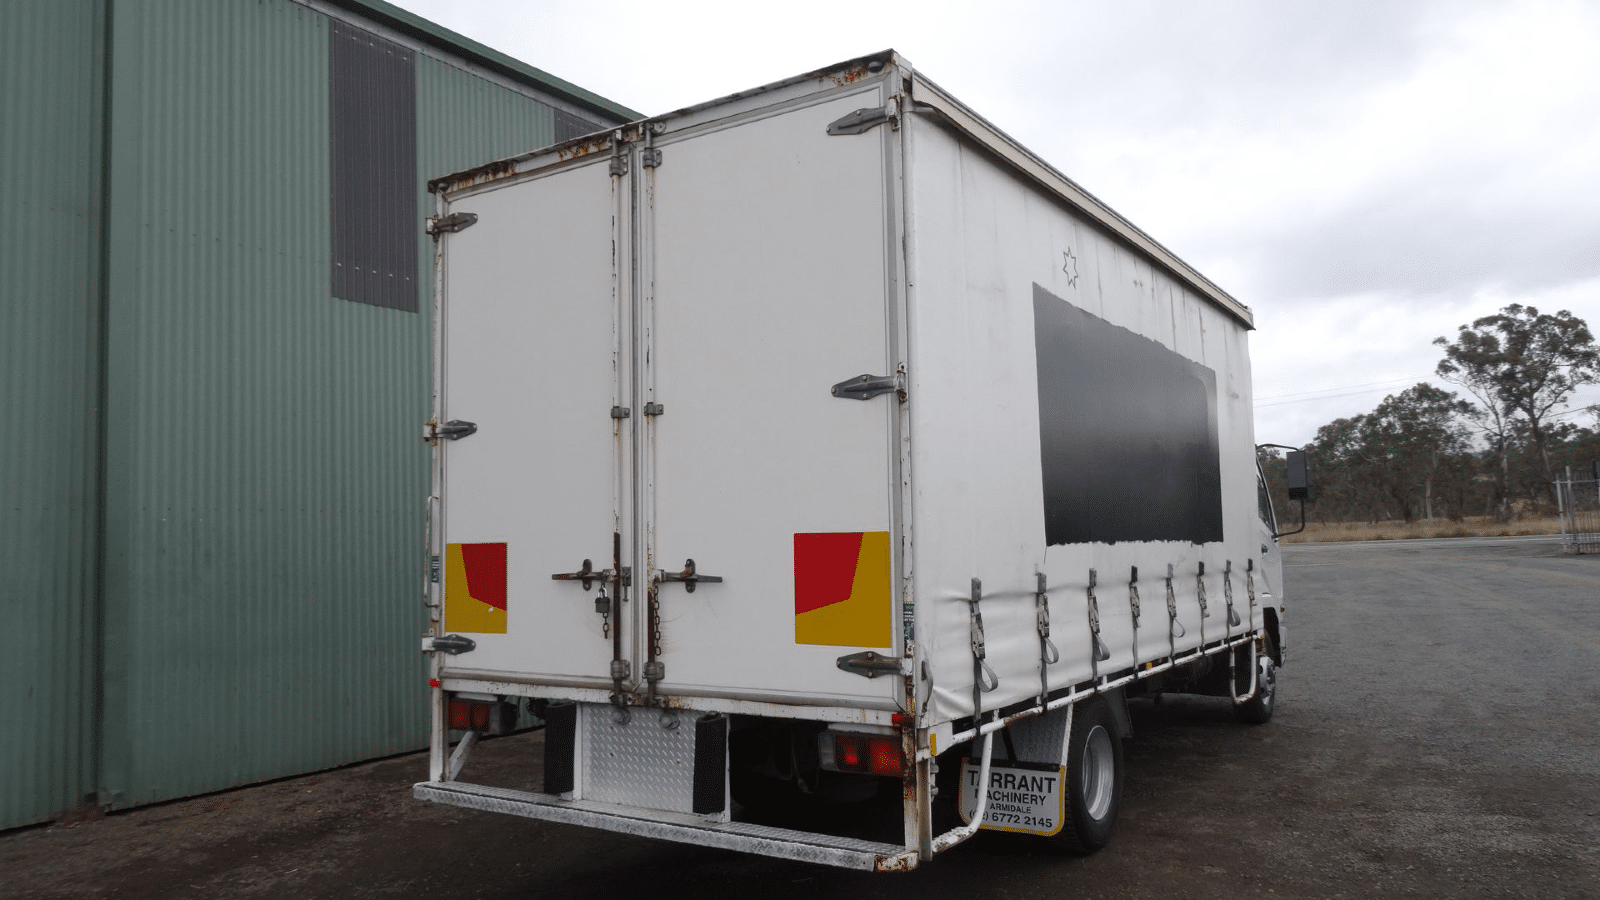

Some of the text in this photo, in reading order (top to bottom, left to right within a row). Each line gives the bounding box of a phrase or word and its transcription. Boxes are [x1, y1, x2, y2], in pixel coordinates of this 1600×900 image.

[967, 770, 1056, 793] TRRANT
[990, 803, 1031, 814] ARMIDALE
[992, 812, 1020, 824] 6772
[1024, 816, 1053, 828] 2145
